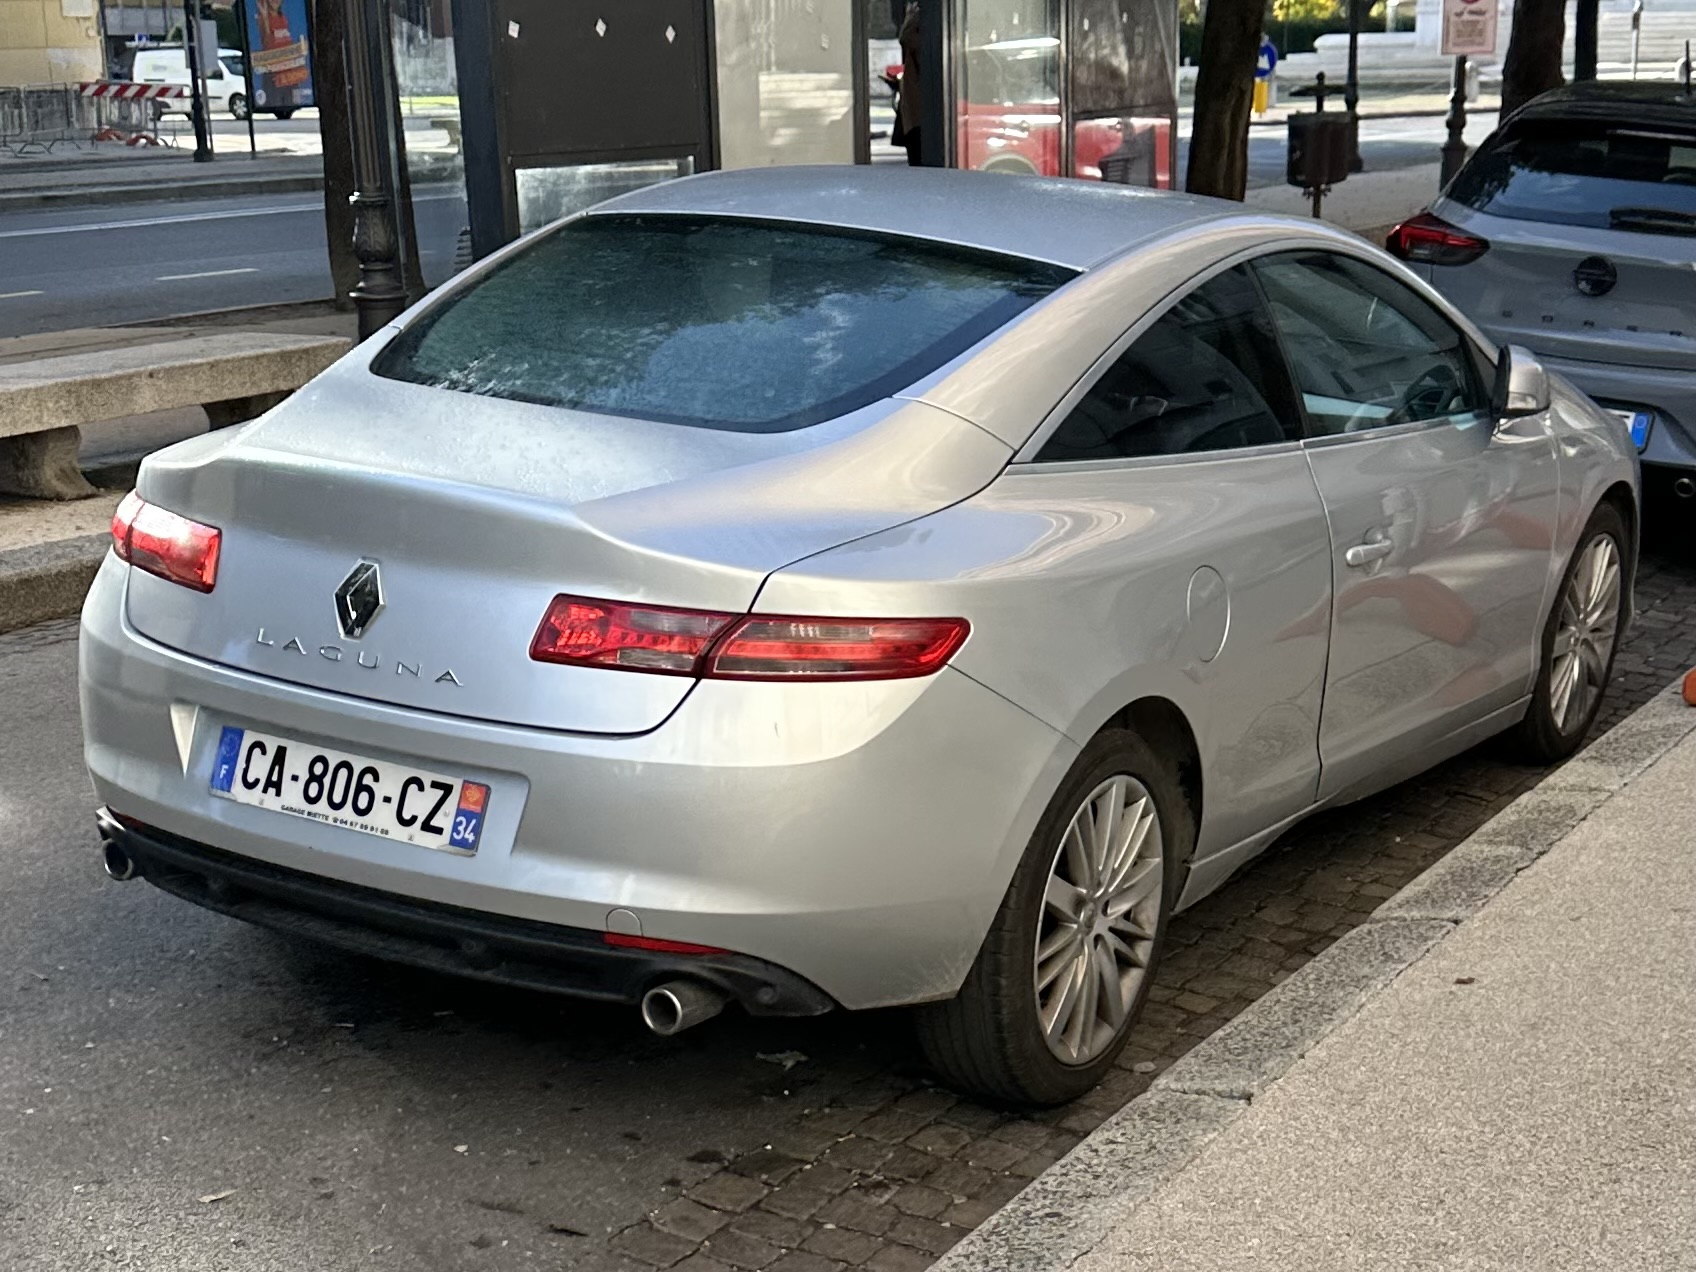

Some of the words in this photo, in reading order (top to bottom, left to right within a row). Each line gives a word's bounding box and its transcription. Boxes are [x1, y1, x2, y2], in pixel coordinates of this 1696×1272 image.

[256, 628, 464, 688] LAGUNA
[219, 764, 229, 780] F
[241, 740, 454, 836] CA-806-CZ
[452, 816, 477, 844] 34
